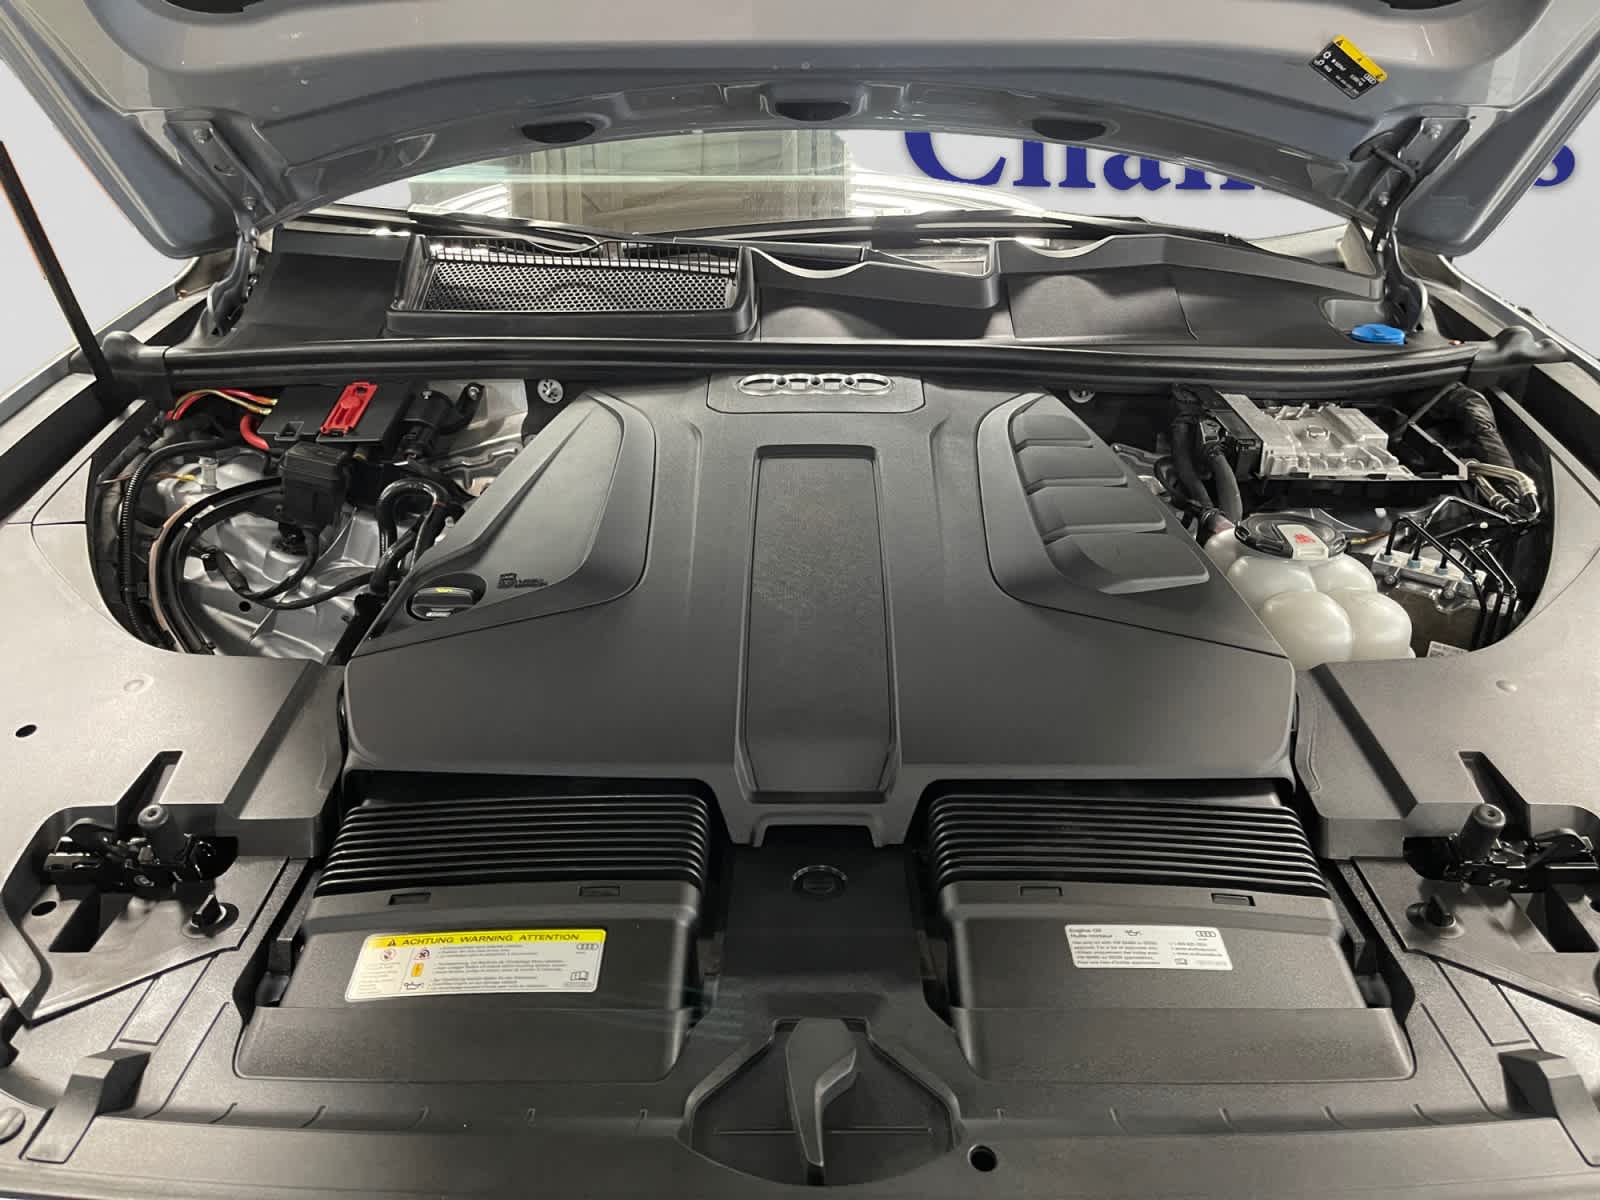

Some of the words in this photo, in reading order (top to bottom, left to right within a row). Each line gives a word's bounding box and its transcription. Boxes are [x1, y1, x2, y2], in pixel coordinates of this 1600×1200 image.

[402, 935, 454, 946] ACHTUNG
[459, 933, 513, 943] WARNING
[519, 932, 580, 942] ATTENTION
